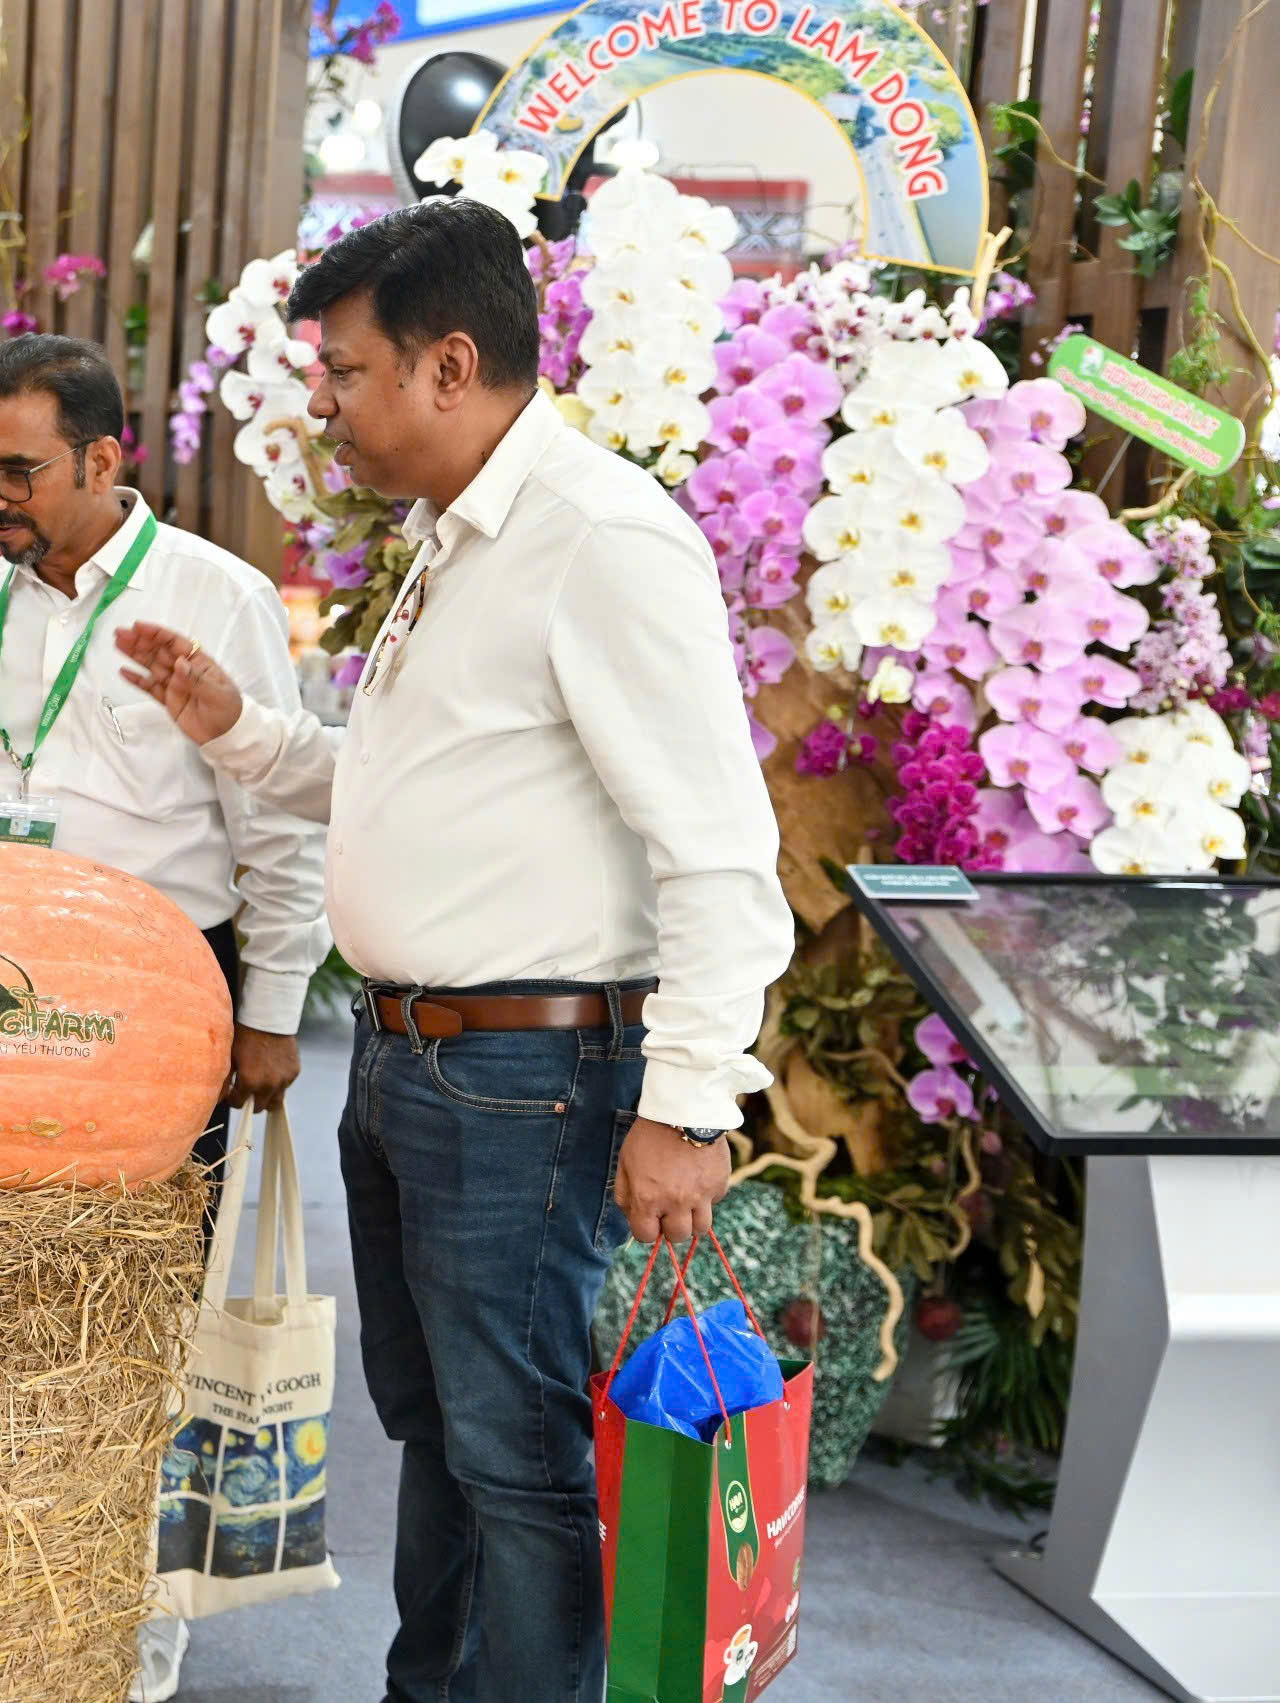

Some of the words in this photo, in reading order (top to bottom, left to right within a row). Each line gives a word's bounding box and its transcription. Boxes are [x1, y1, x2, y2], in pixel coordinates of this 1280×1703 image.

[519, 0, 702, 133] WELCOME
[720, 0, 778, 33] TO
[791, 8, 880, 79] LAM
[869, 73, 943, 197] DONG
[185, 1373, 256, 1407] VINCENT
[275, 1372, 321, 1395] GOGH
[212, 1403, 234, 1418] THE
[262, 1400, 294, 1417] NIGHT
